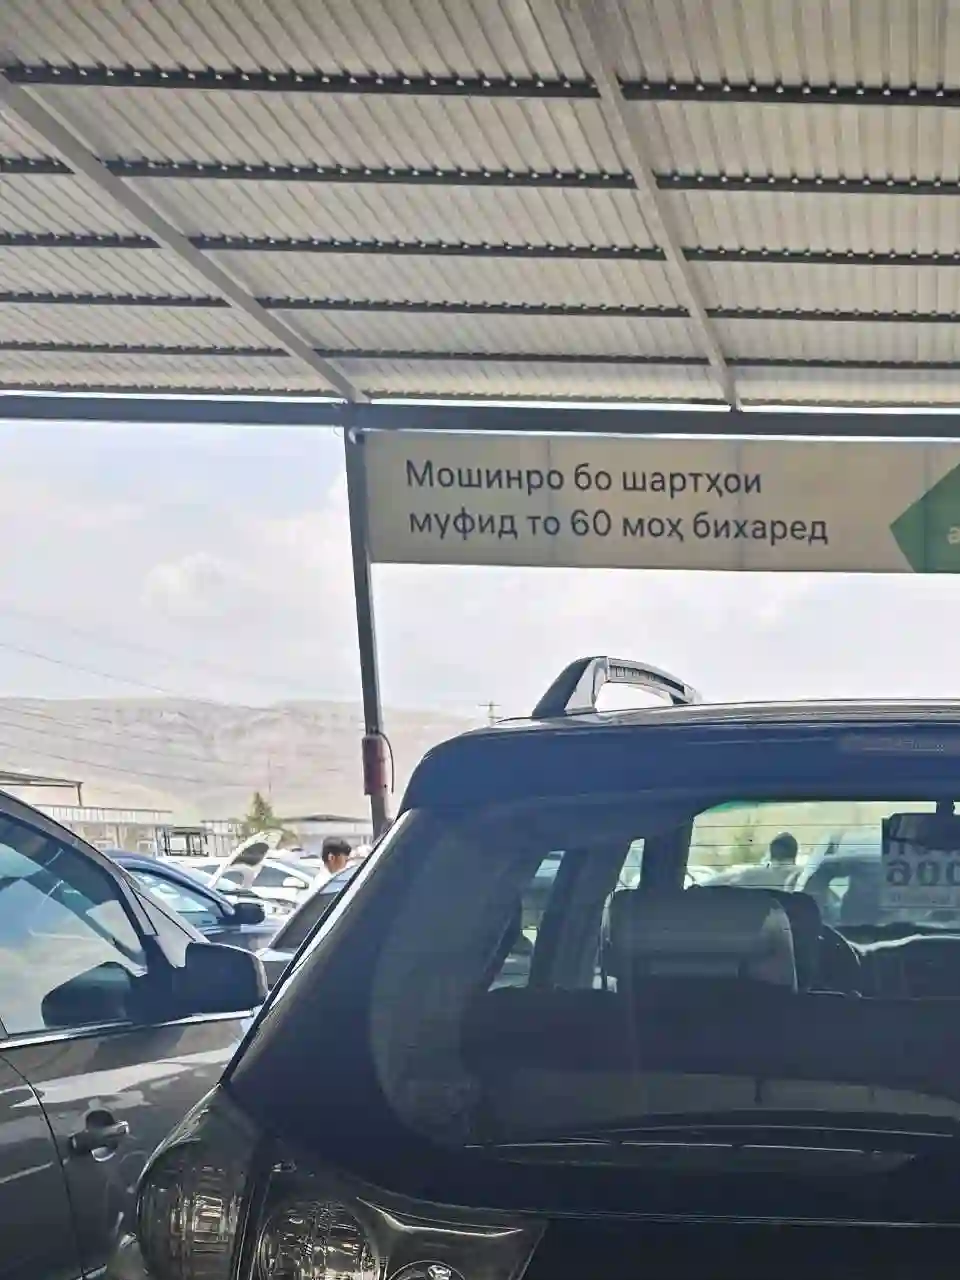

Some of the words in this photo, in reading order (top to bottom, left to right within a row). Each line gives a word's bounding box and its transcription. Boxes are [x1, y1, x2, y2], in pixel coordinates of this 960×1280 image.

[406, 460, 564, 496] Мошинро
[574, 463, 613, 490] бо
[622, 471, 761, 499] шартҳои
[409, 506, 518, 540] муфид
[527, 515, 560, 536] то
[571, 509, 611, 536] 60
[622, 516, 684, 542] моҳ
[693, 511, 828, 546] бихаред
